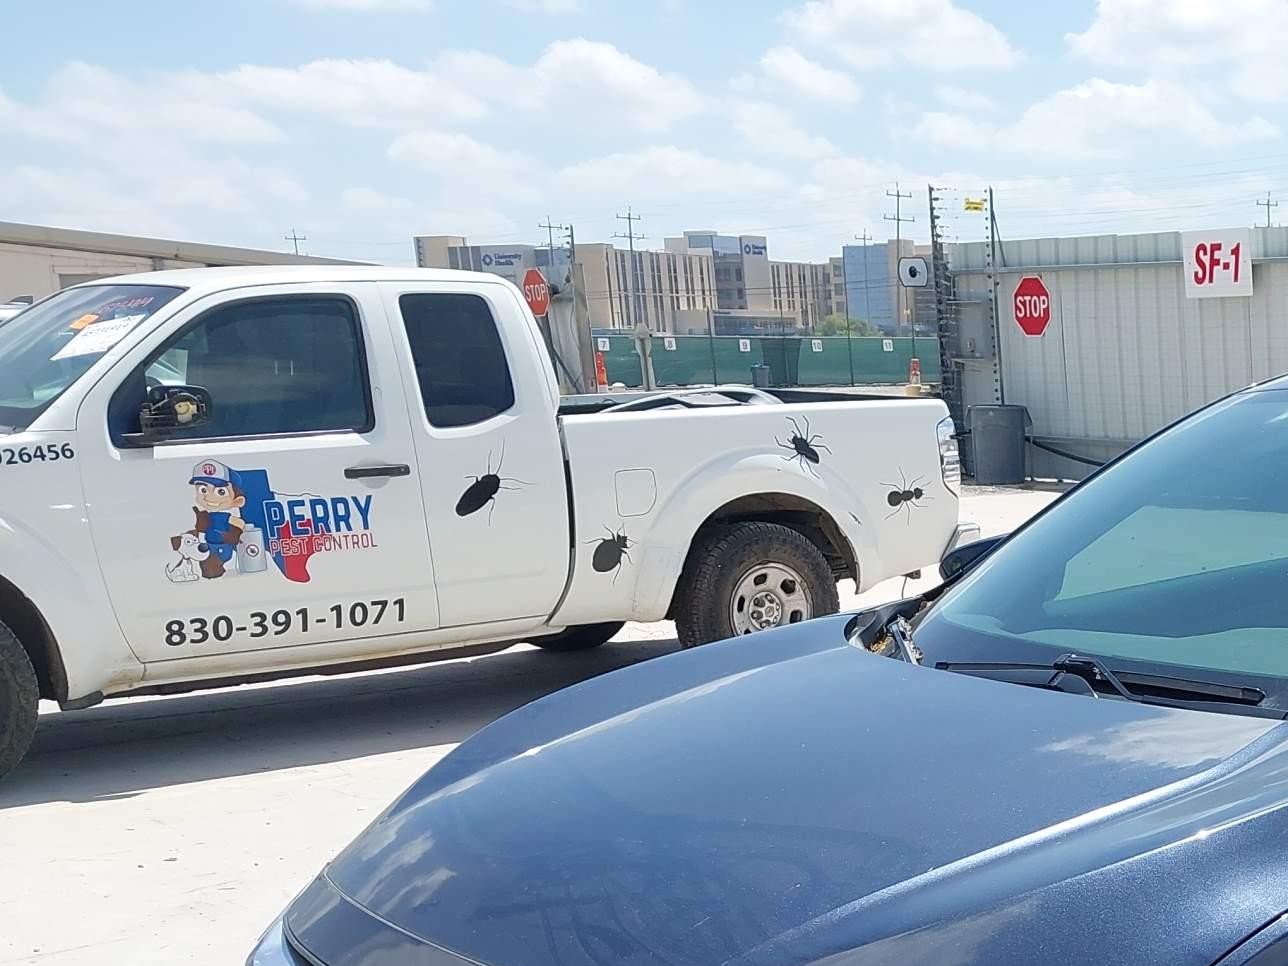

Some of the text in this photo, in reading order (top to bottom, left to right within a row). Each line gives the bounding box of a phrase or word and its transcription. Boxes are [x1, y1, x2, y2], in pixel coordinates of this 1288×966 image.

[1193, 241, 1242, 286] SF-1
[525, 283, 546, 302] STOP
[1016, 295, 1049, 318] STOP
[812, 340, 822, 350] 10
[884, 340, 892, 350] 11
[263, 494, 373, 538] PERRY
[270, 532, 379, 557] PEST CONTROL
[164, 598, 406, 647] 830-391-1071
